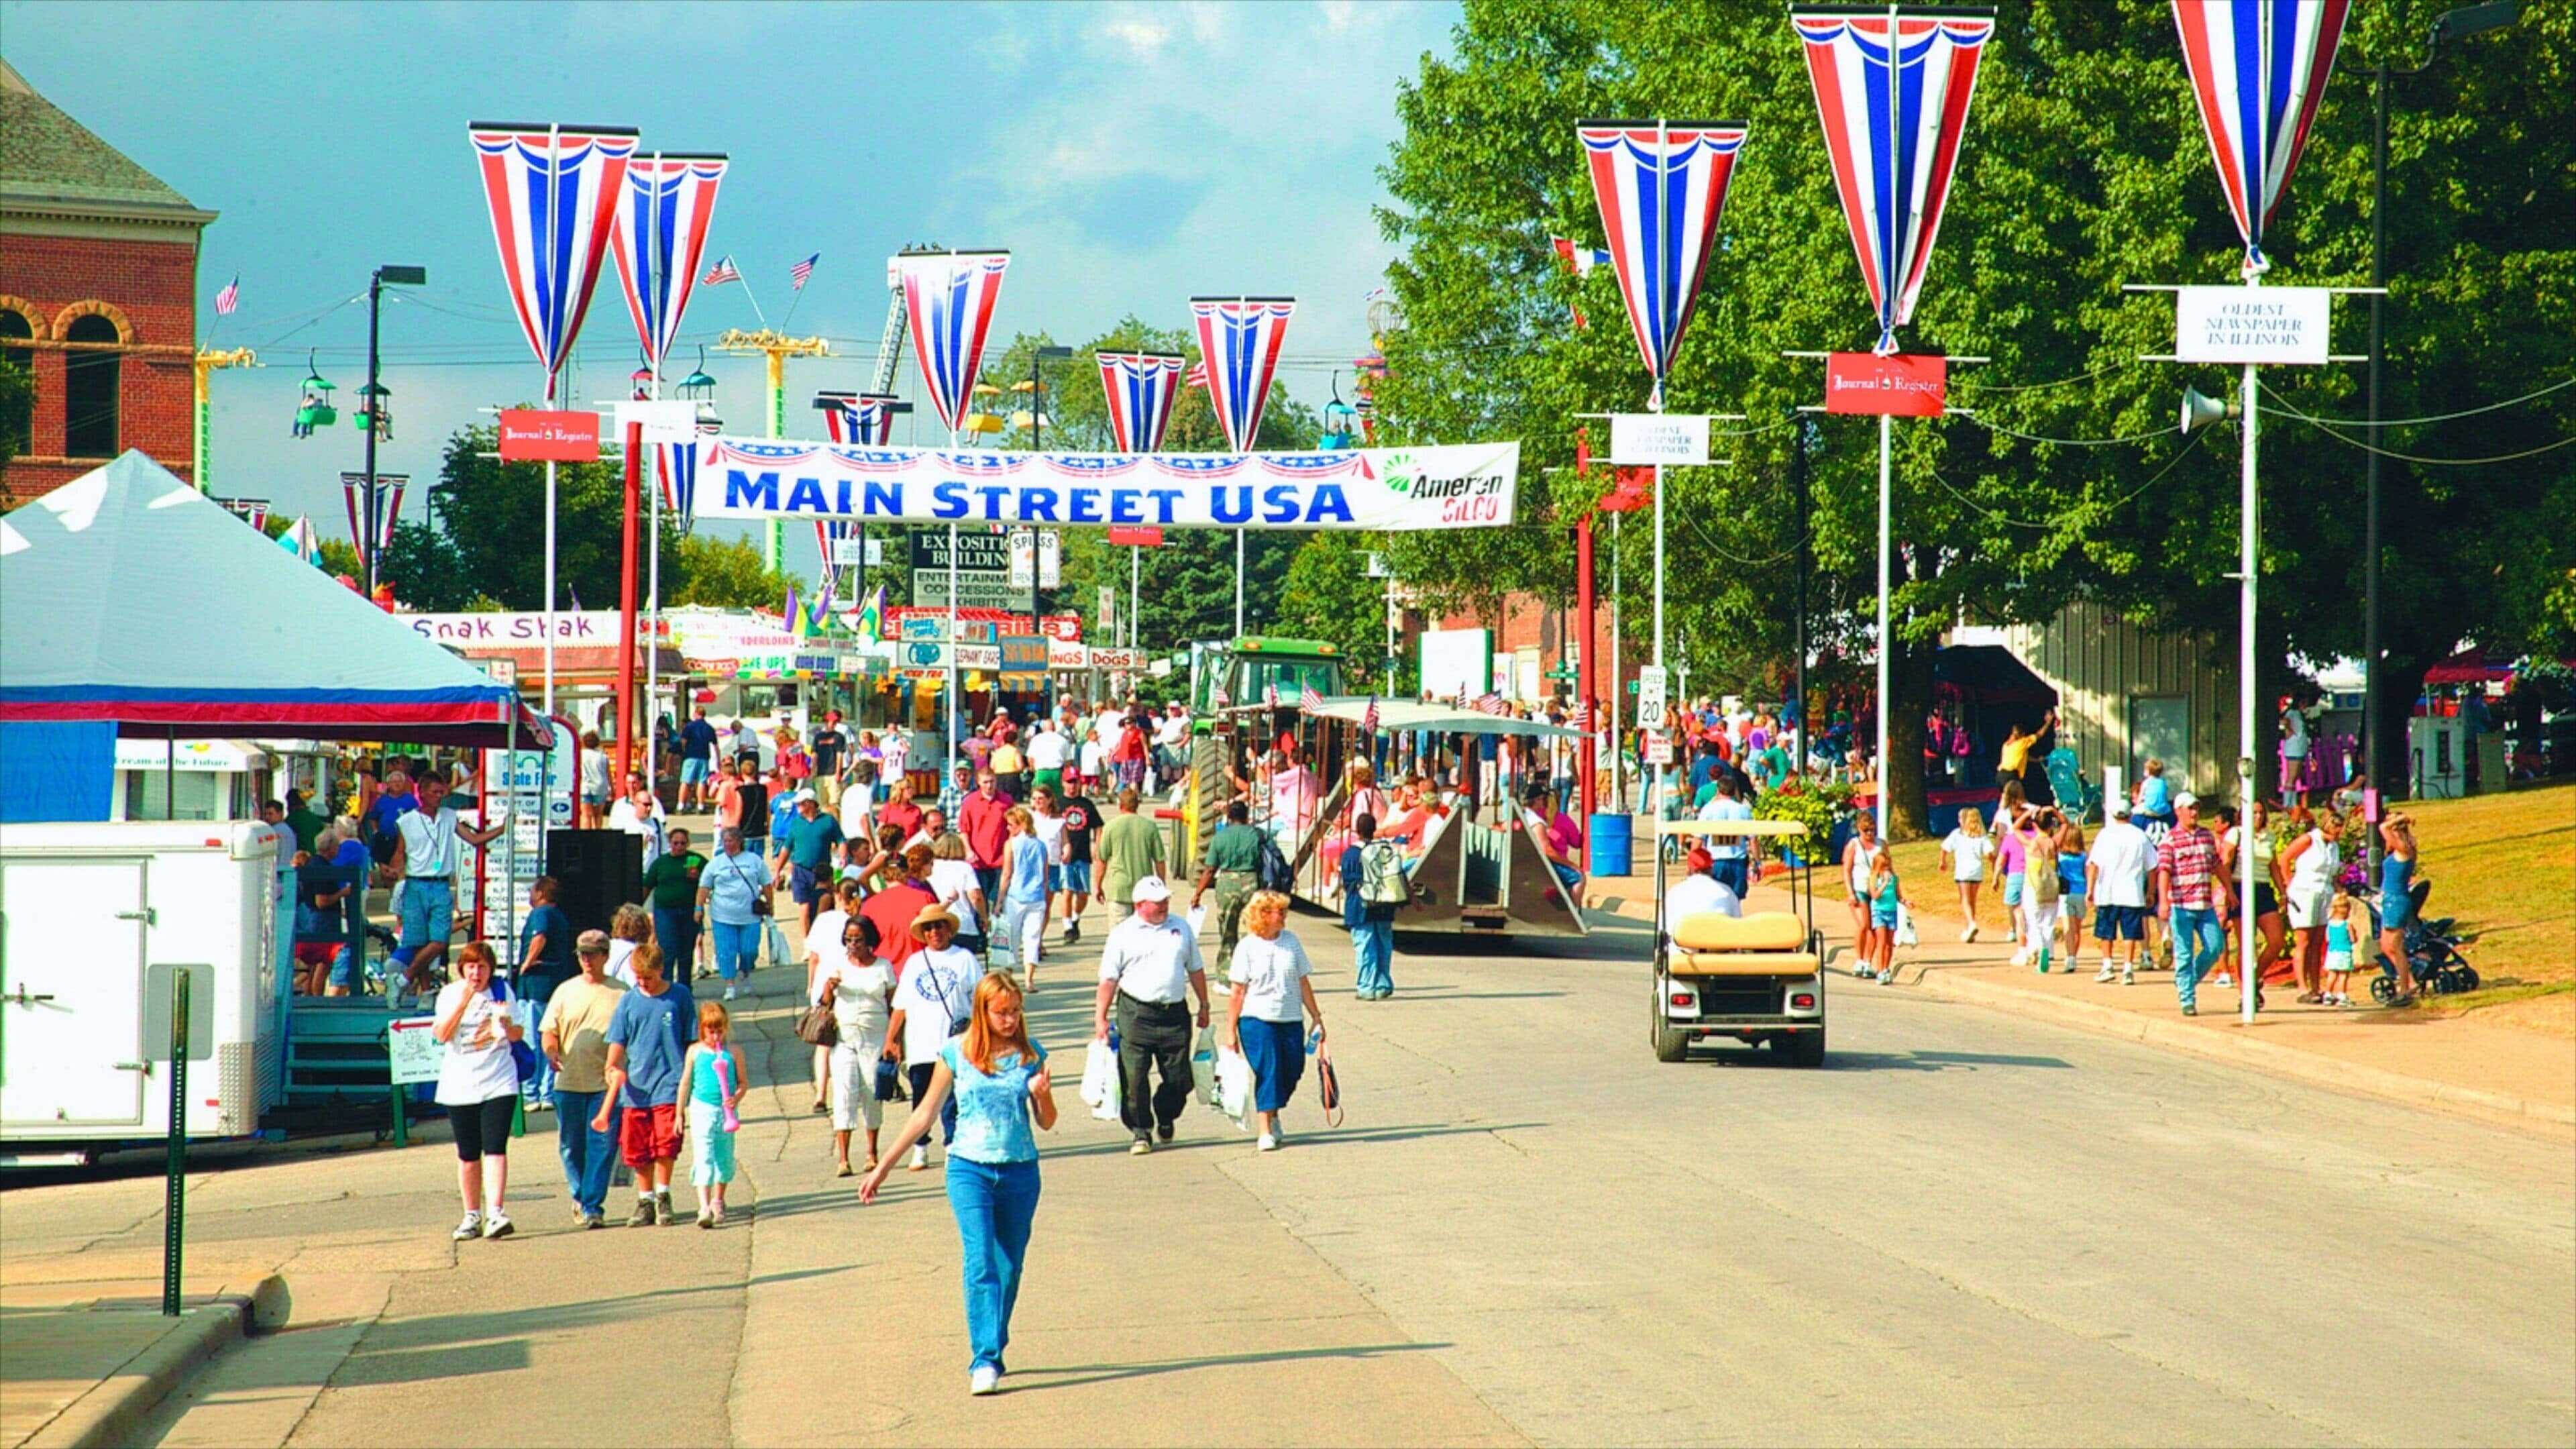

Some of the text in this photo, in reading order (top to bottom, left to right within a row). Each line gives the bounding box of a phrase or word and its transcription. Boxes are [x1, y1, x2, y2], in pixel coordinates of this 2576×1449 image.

[2222, 303, 2285, 315] OLDEST
[2206, 318, 2302, 331] NEWSPAPER
[2208, 333, 2300, 345] IN ILLINOIS
[1833, 374, 1938, 394] Journal Register
[725, 470, 1356, 523] MAIN STREET USA
[1014, 536, 1054, 549] SPISS
[932, 551, 1007, 565] BUILDIN
[917, 572, 1007, 582] ENTERTAINM
[945, 598, 1007, 607] EXHIBITS
[413, 618, 495, 639] Snak
[1092, 652, 1130, 665] DOGS
[1642, 700, 1660, 722] 20
